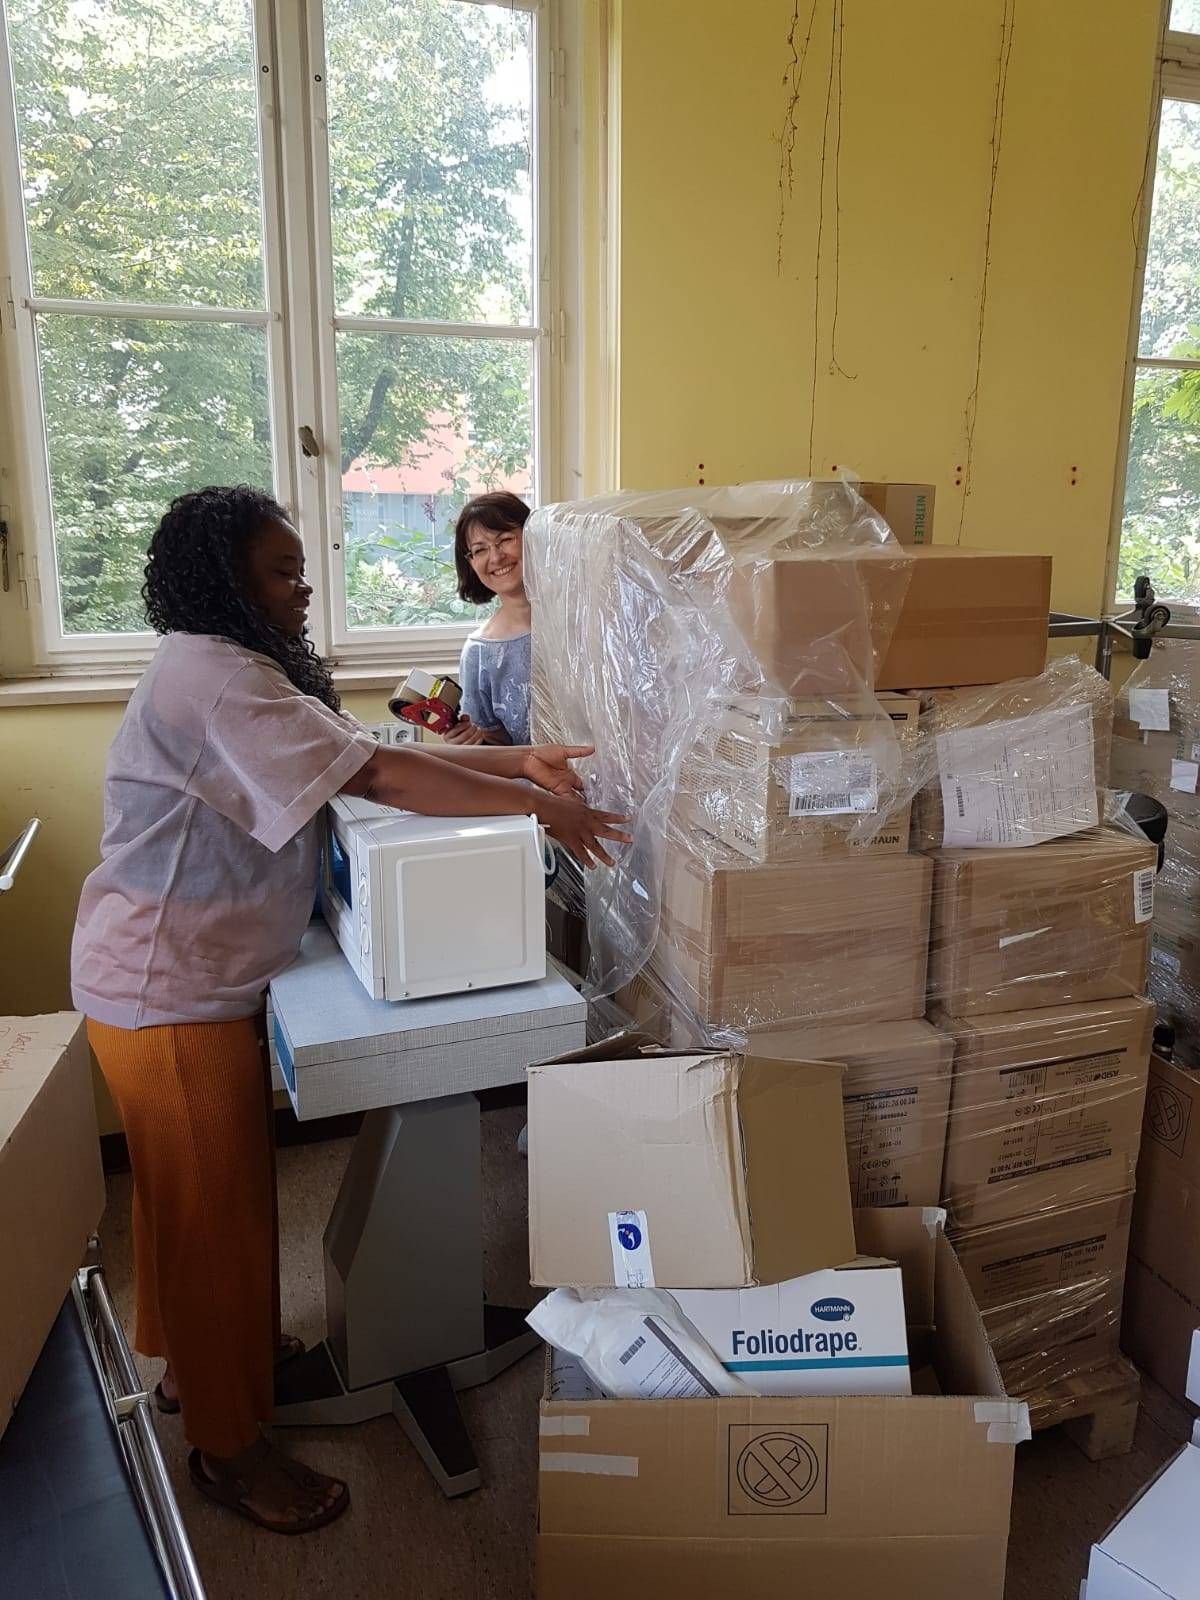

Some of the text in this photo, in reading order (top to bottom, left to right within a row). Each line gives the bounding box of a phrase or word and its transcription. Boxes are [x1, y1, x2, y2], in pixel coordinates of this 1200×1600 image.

[913, 496, 926, 537] NITRILE
[814, 1304, 851, 1314] HARTMANN
[732, 1328, 858, 1357] Foliodrape
